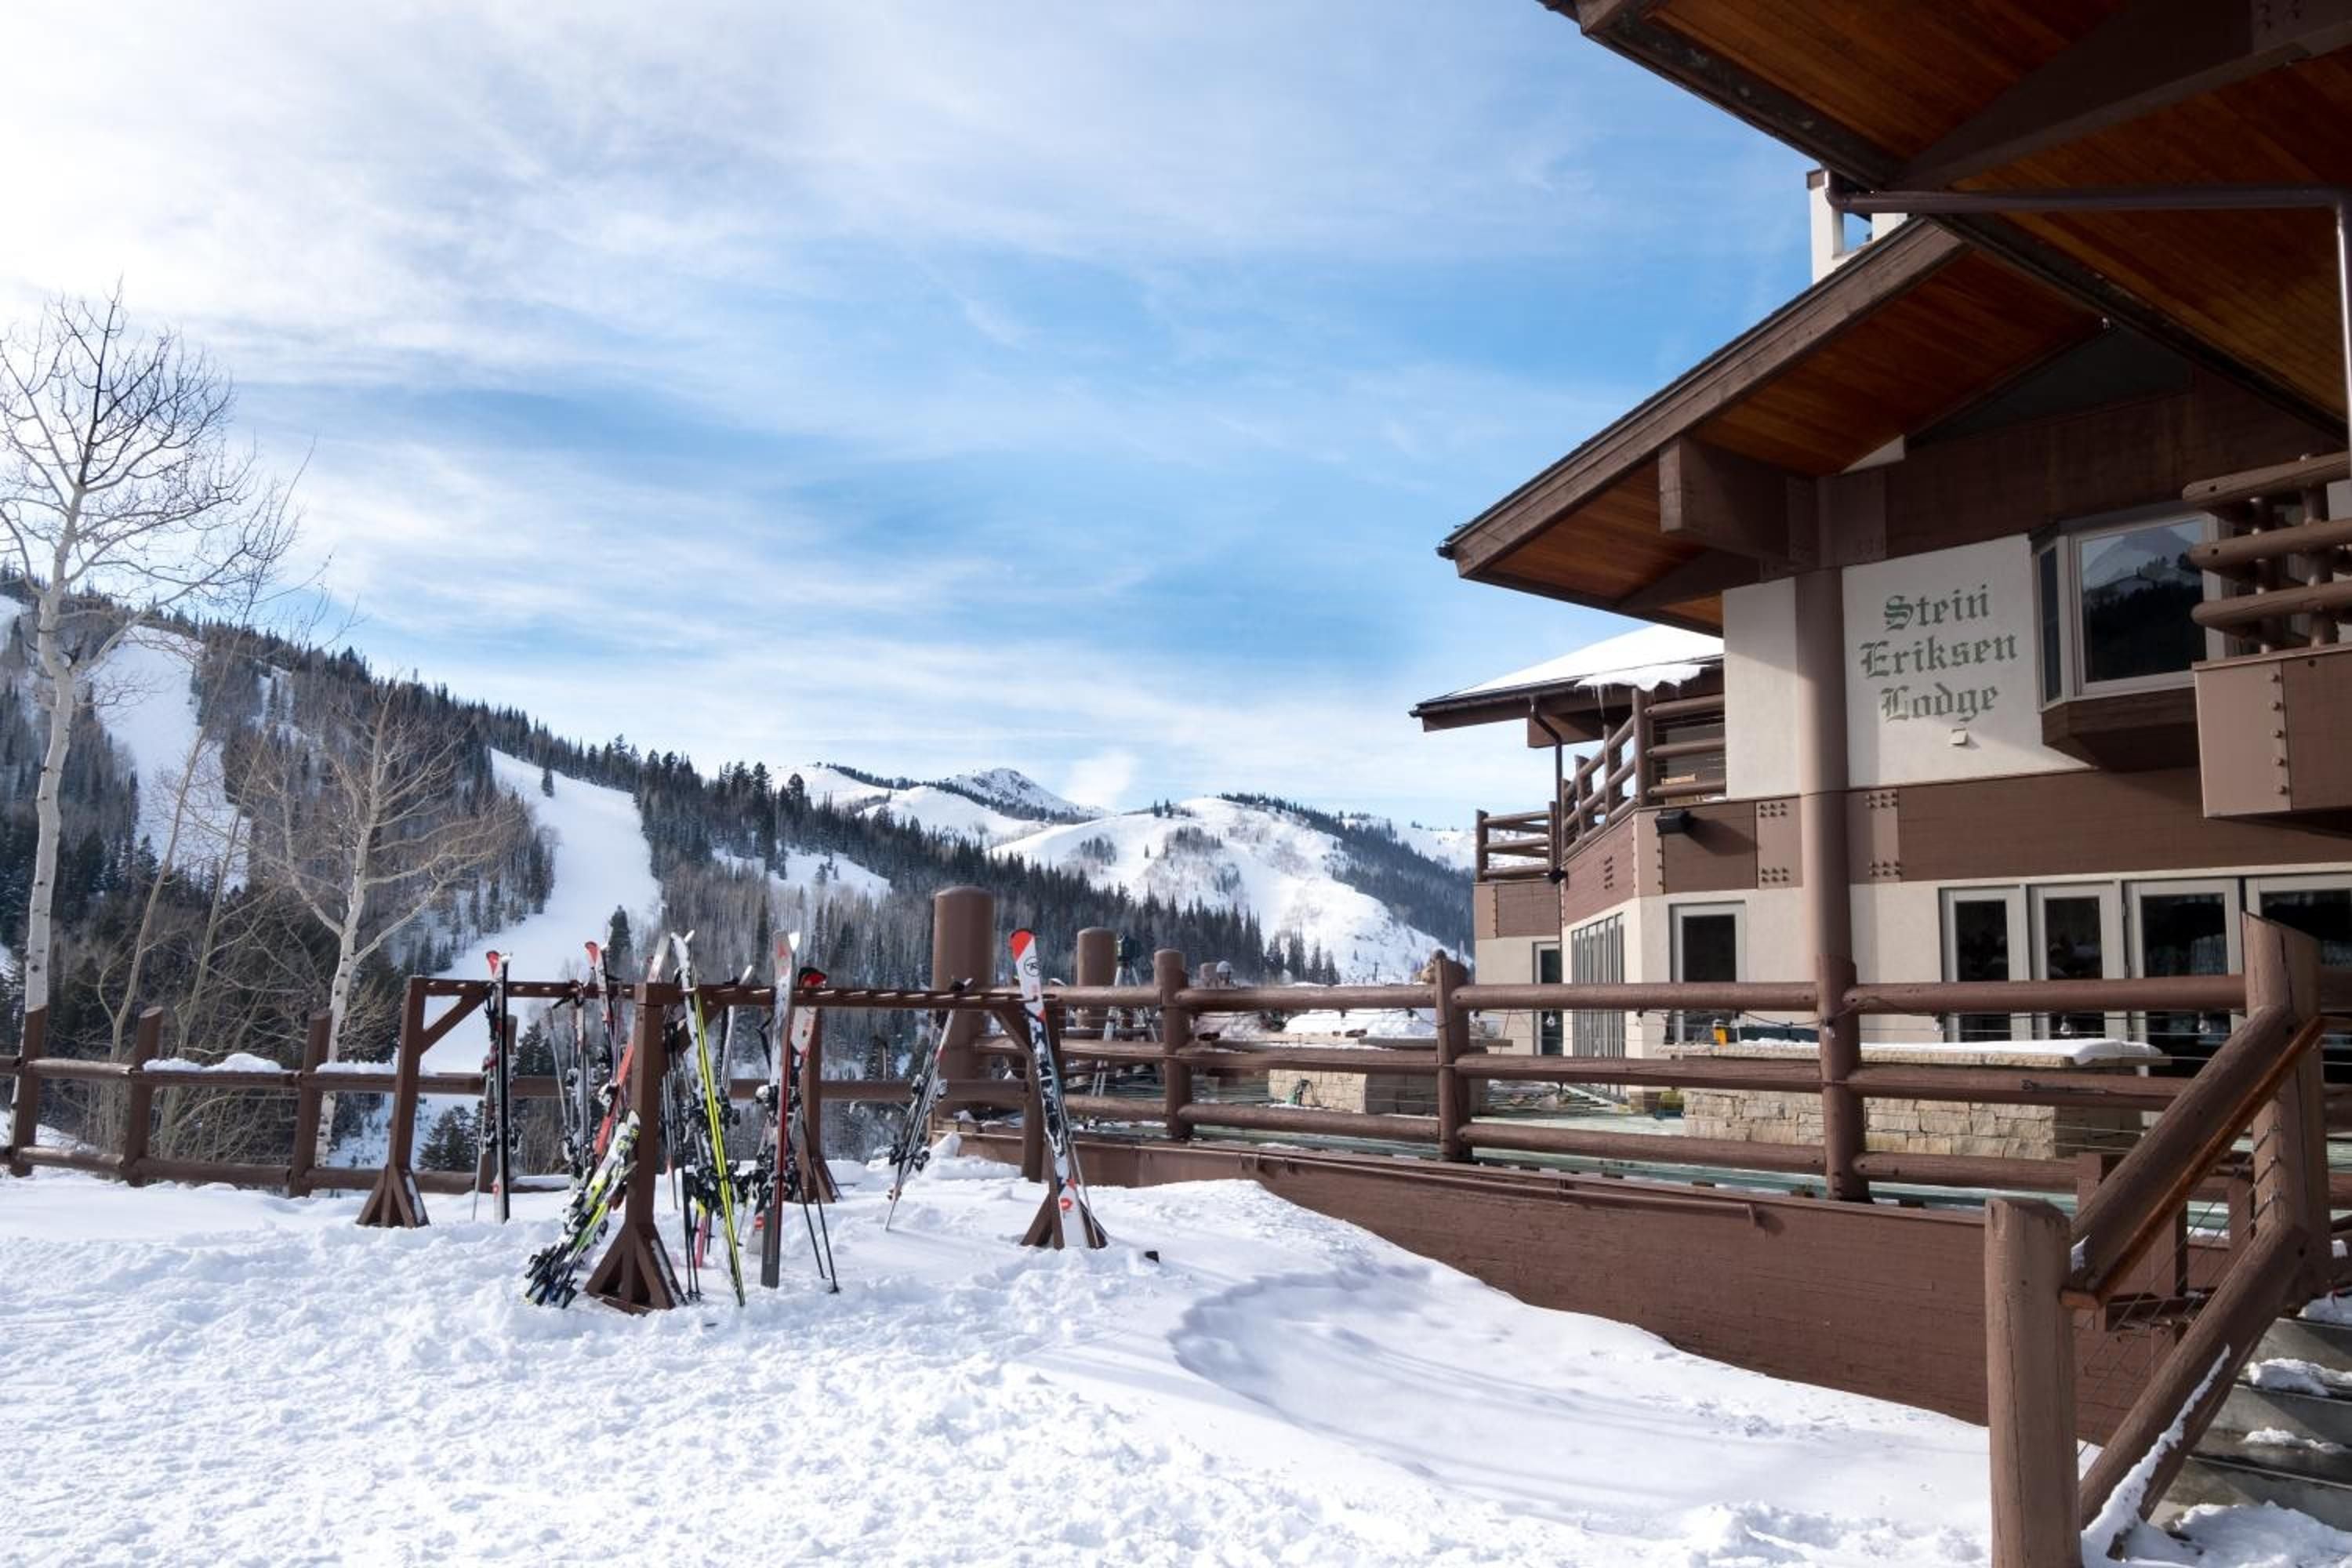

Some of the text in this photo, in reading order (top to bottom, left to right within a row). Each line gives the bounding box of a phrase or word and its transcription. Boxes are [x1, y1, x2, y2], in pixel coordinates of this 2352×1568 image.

[1884, 584, 1990, 631] Stein
[1860, 633, 2018, 679] Eriksen
[1882, 682, 1998, 722] Lodge
